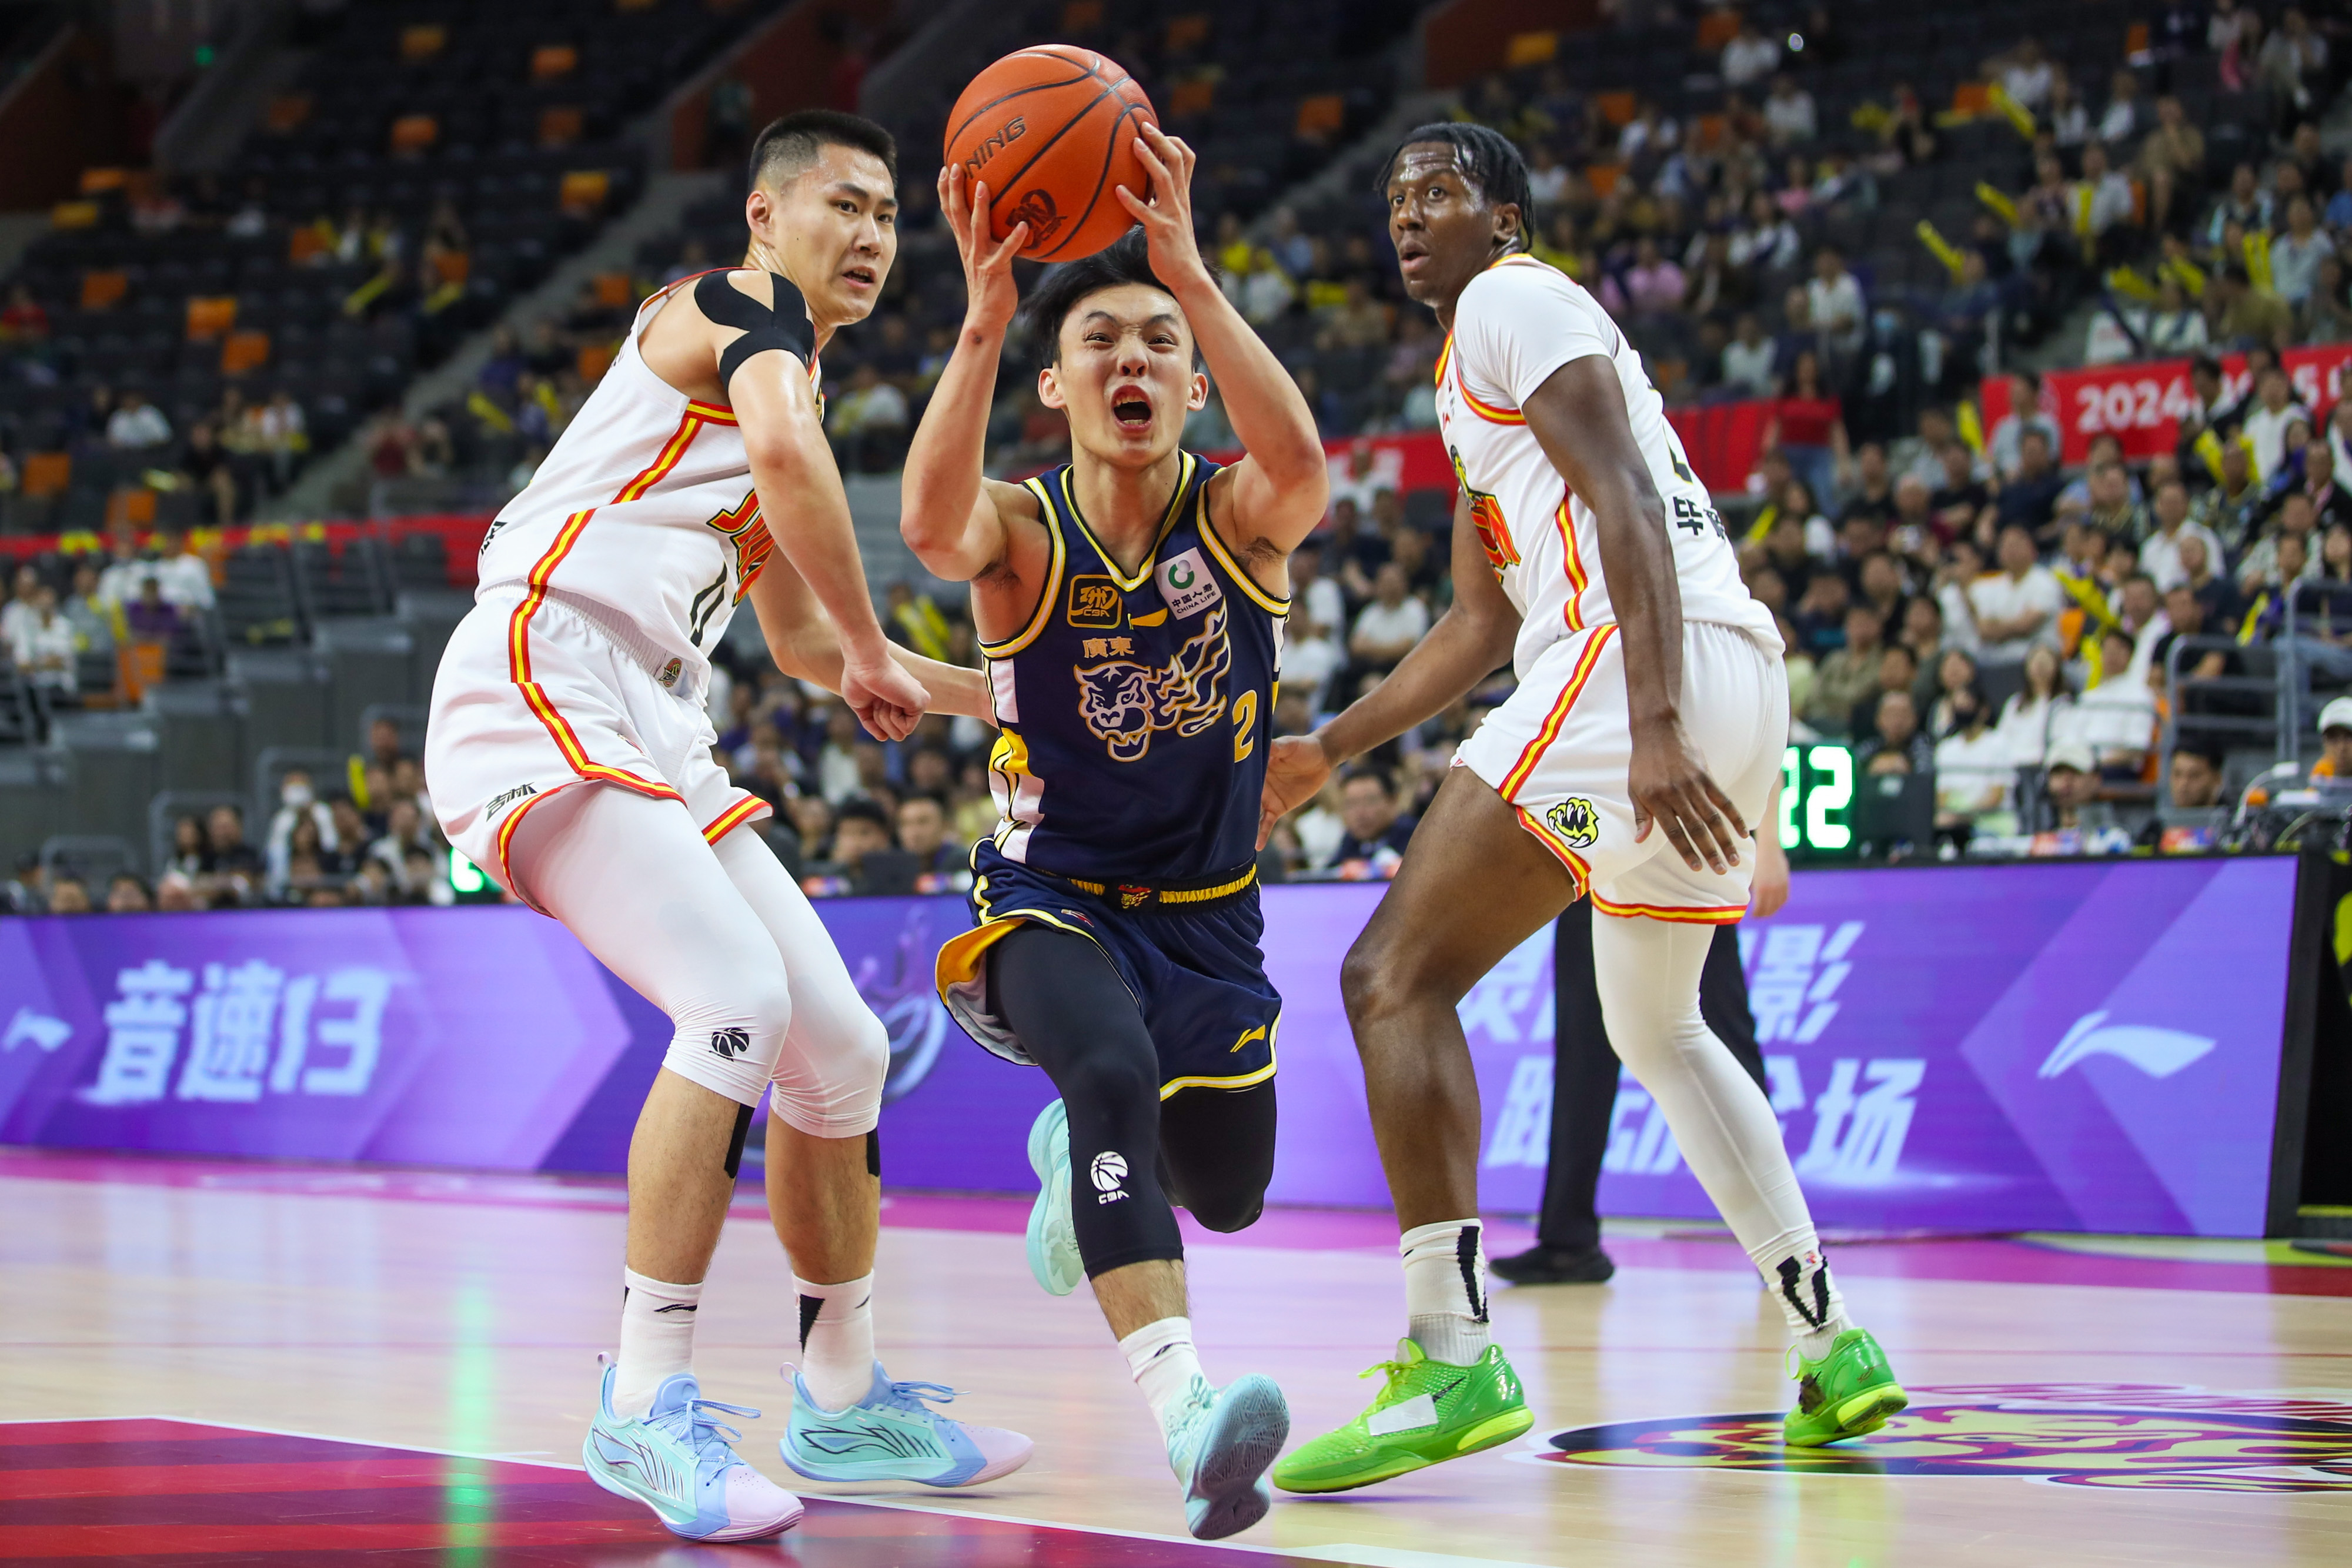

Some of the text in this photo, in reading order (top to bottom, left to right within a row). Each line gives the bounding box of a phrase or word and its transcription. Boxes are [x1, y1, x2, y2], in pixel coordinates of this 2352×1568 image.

[1171, 583, 1213, 607] 中国人寿
[1177, 590, 1217, 614] CHINA LIFE
[1083, 609, 1110, 617] CBA
[1082, 636, 1135, 658] 廣東
[1232, 689, 1257, 763] 2
[485, 781, 537, 823] 吉林
[75, 959, 393, 1106] 音速13
